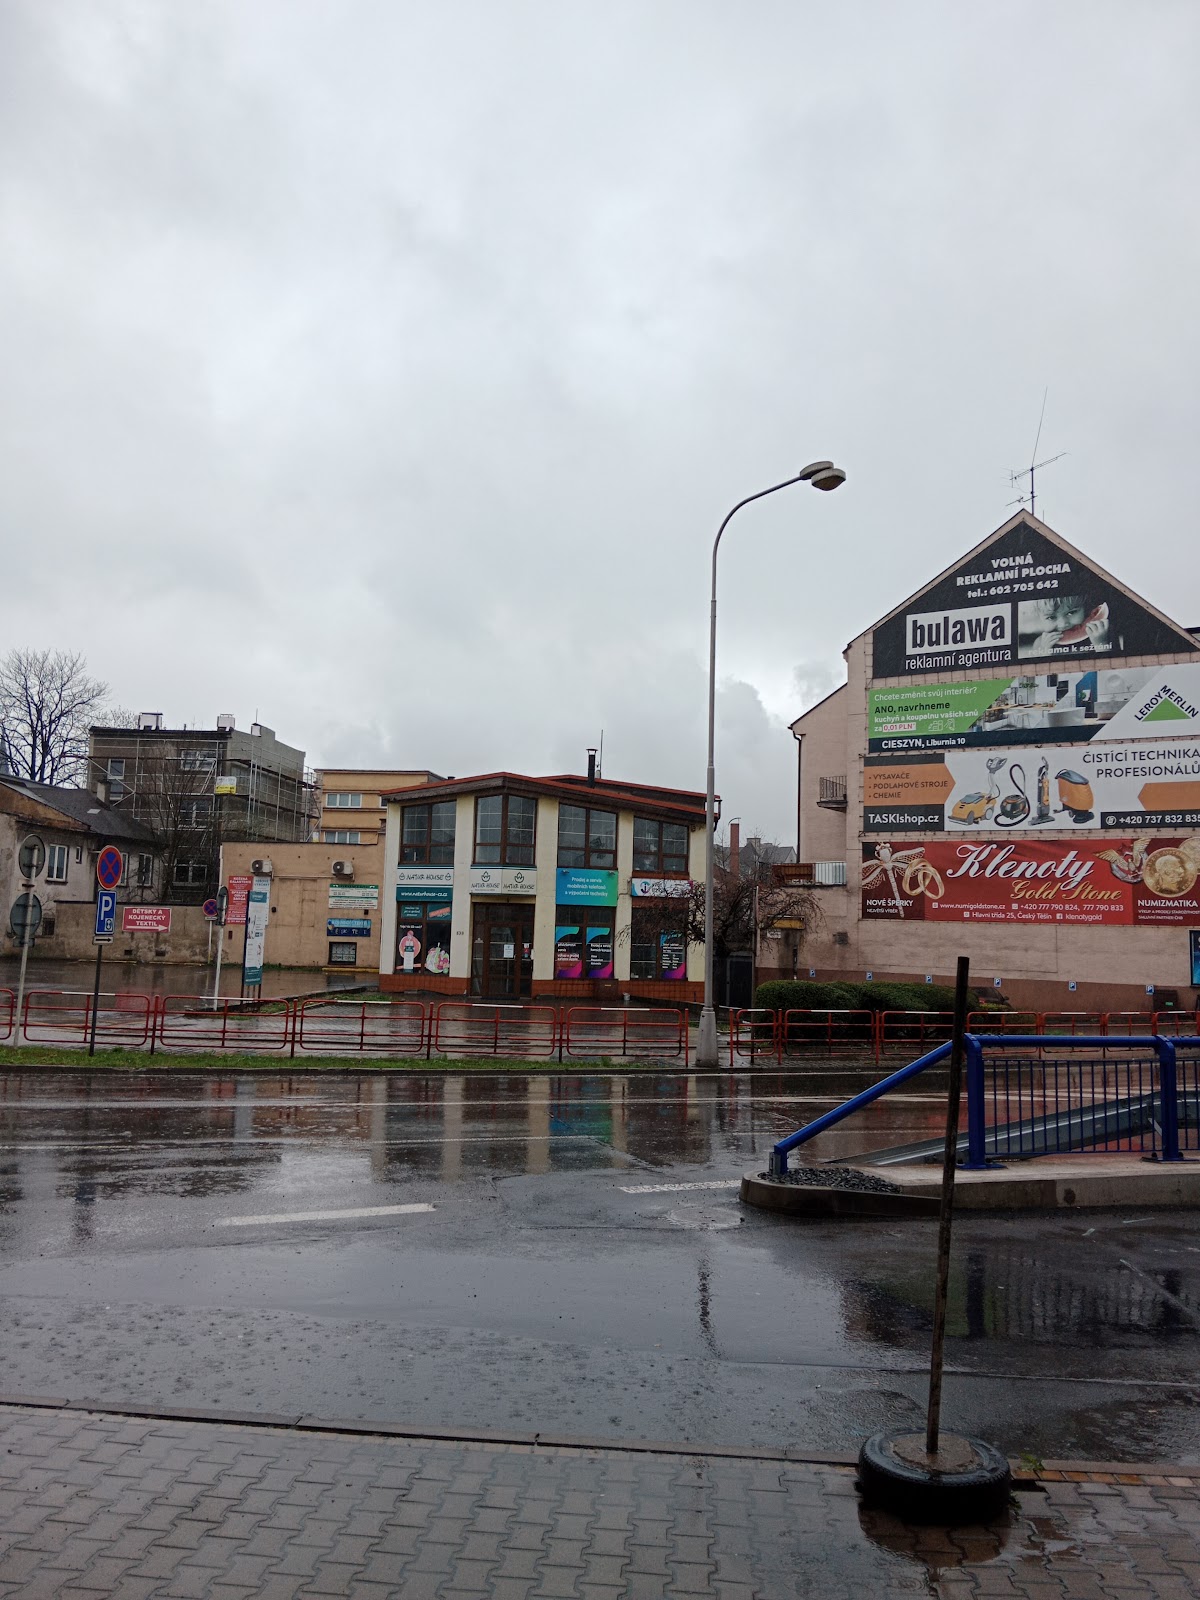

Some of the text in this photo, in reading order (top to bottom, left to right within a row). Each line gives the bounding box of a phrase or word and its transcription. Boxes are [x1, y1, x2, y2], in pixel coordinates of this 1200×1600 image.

[992, 552, 1033, 568] VOLNÁ
[956, 563, 1071, 586] REKLAMNÍ PLOCHA
[968, 580, 1059, 598] tel.: 602 705 642
[912, 615, 1005, 648] bulawa
[1028, 647, 1069, 656] reklama
[906, 650, 1011, 670] reklamní agentura
[901, 691, 927, 699] změnit
[928, 689, 943, 698] svůj
[944, 687, 977, 696] interiér?
[874, 702, 950, 714] ANO, navrhneme
[1134, 685, 1199, 720] LEROY MERLIN
[874, 715, 899, 723] kuchyň
[906, 712, 939, 721] koupelnu
[882, 739, 925, 748] CIESZYN,
[1082, 748, 1200, 764] ČISTÍCÍ TECHNIKA
[1097, 761, 1200, 778] PROFESIONÁLŮ
[873, 781, 919, 789] PODLAHOVÉ
[868, 813, 939, 825] TASKIshop.cz
[1165, 815, 1182, 823] 832
[946, 844, 1095, 891] Klenoty
[1010, 880, 1122, 900] Gold Stone
[101, 896, 112, 920] P
[866, 898, 914, 906] NOVÉ ŠPERKY
